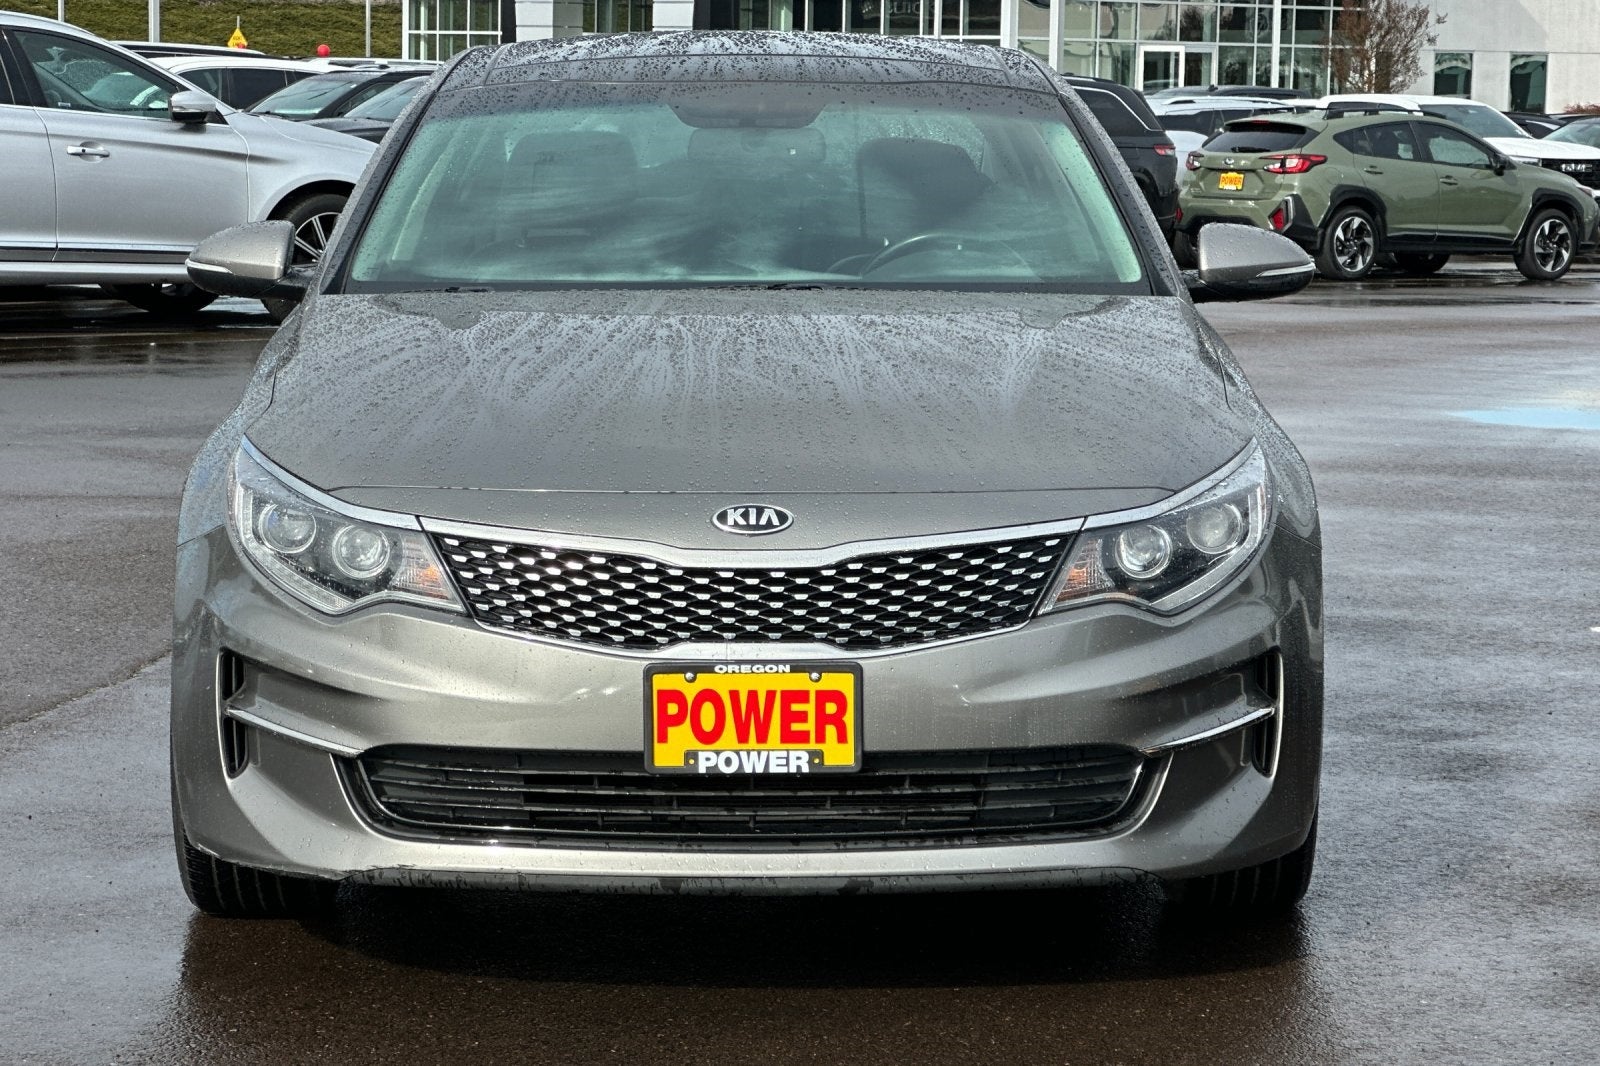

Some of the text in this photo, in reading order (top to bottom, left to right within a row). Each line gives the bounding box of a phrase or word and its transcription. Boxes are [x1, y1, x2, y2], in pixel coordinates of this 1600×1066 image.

[1221, 176, 1242, 186] POWER
[726, 507, 780, 526] KIA
[714, 664, 791, 674] OREGON
[656, 688, 848, 746] POWER
[698, 750, 810, 774] POWER
